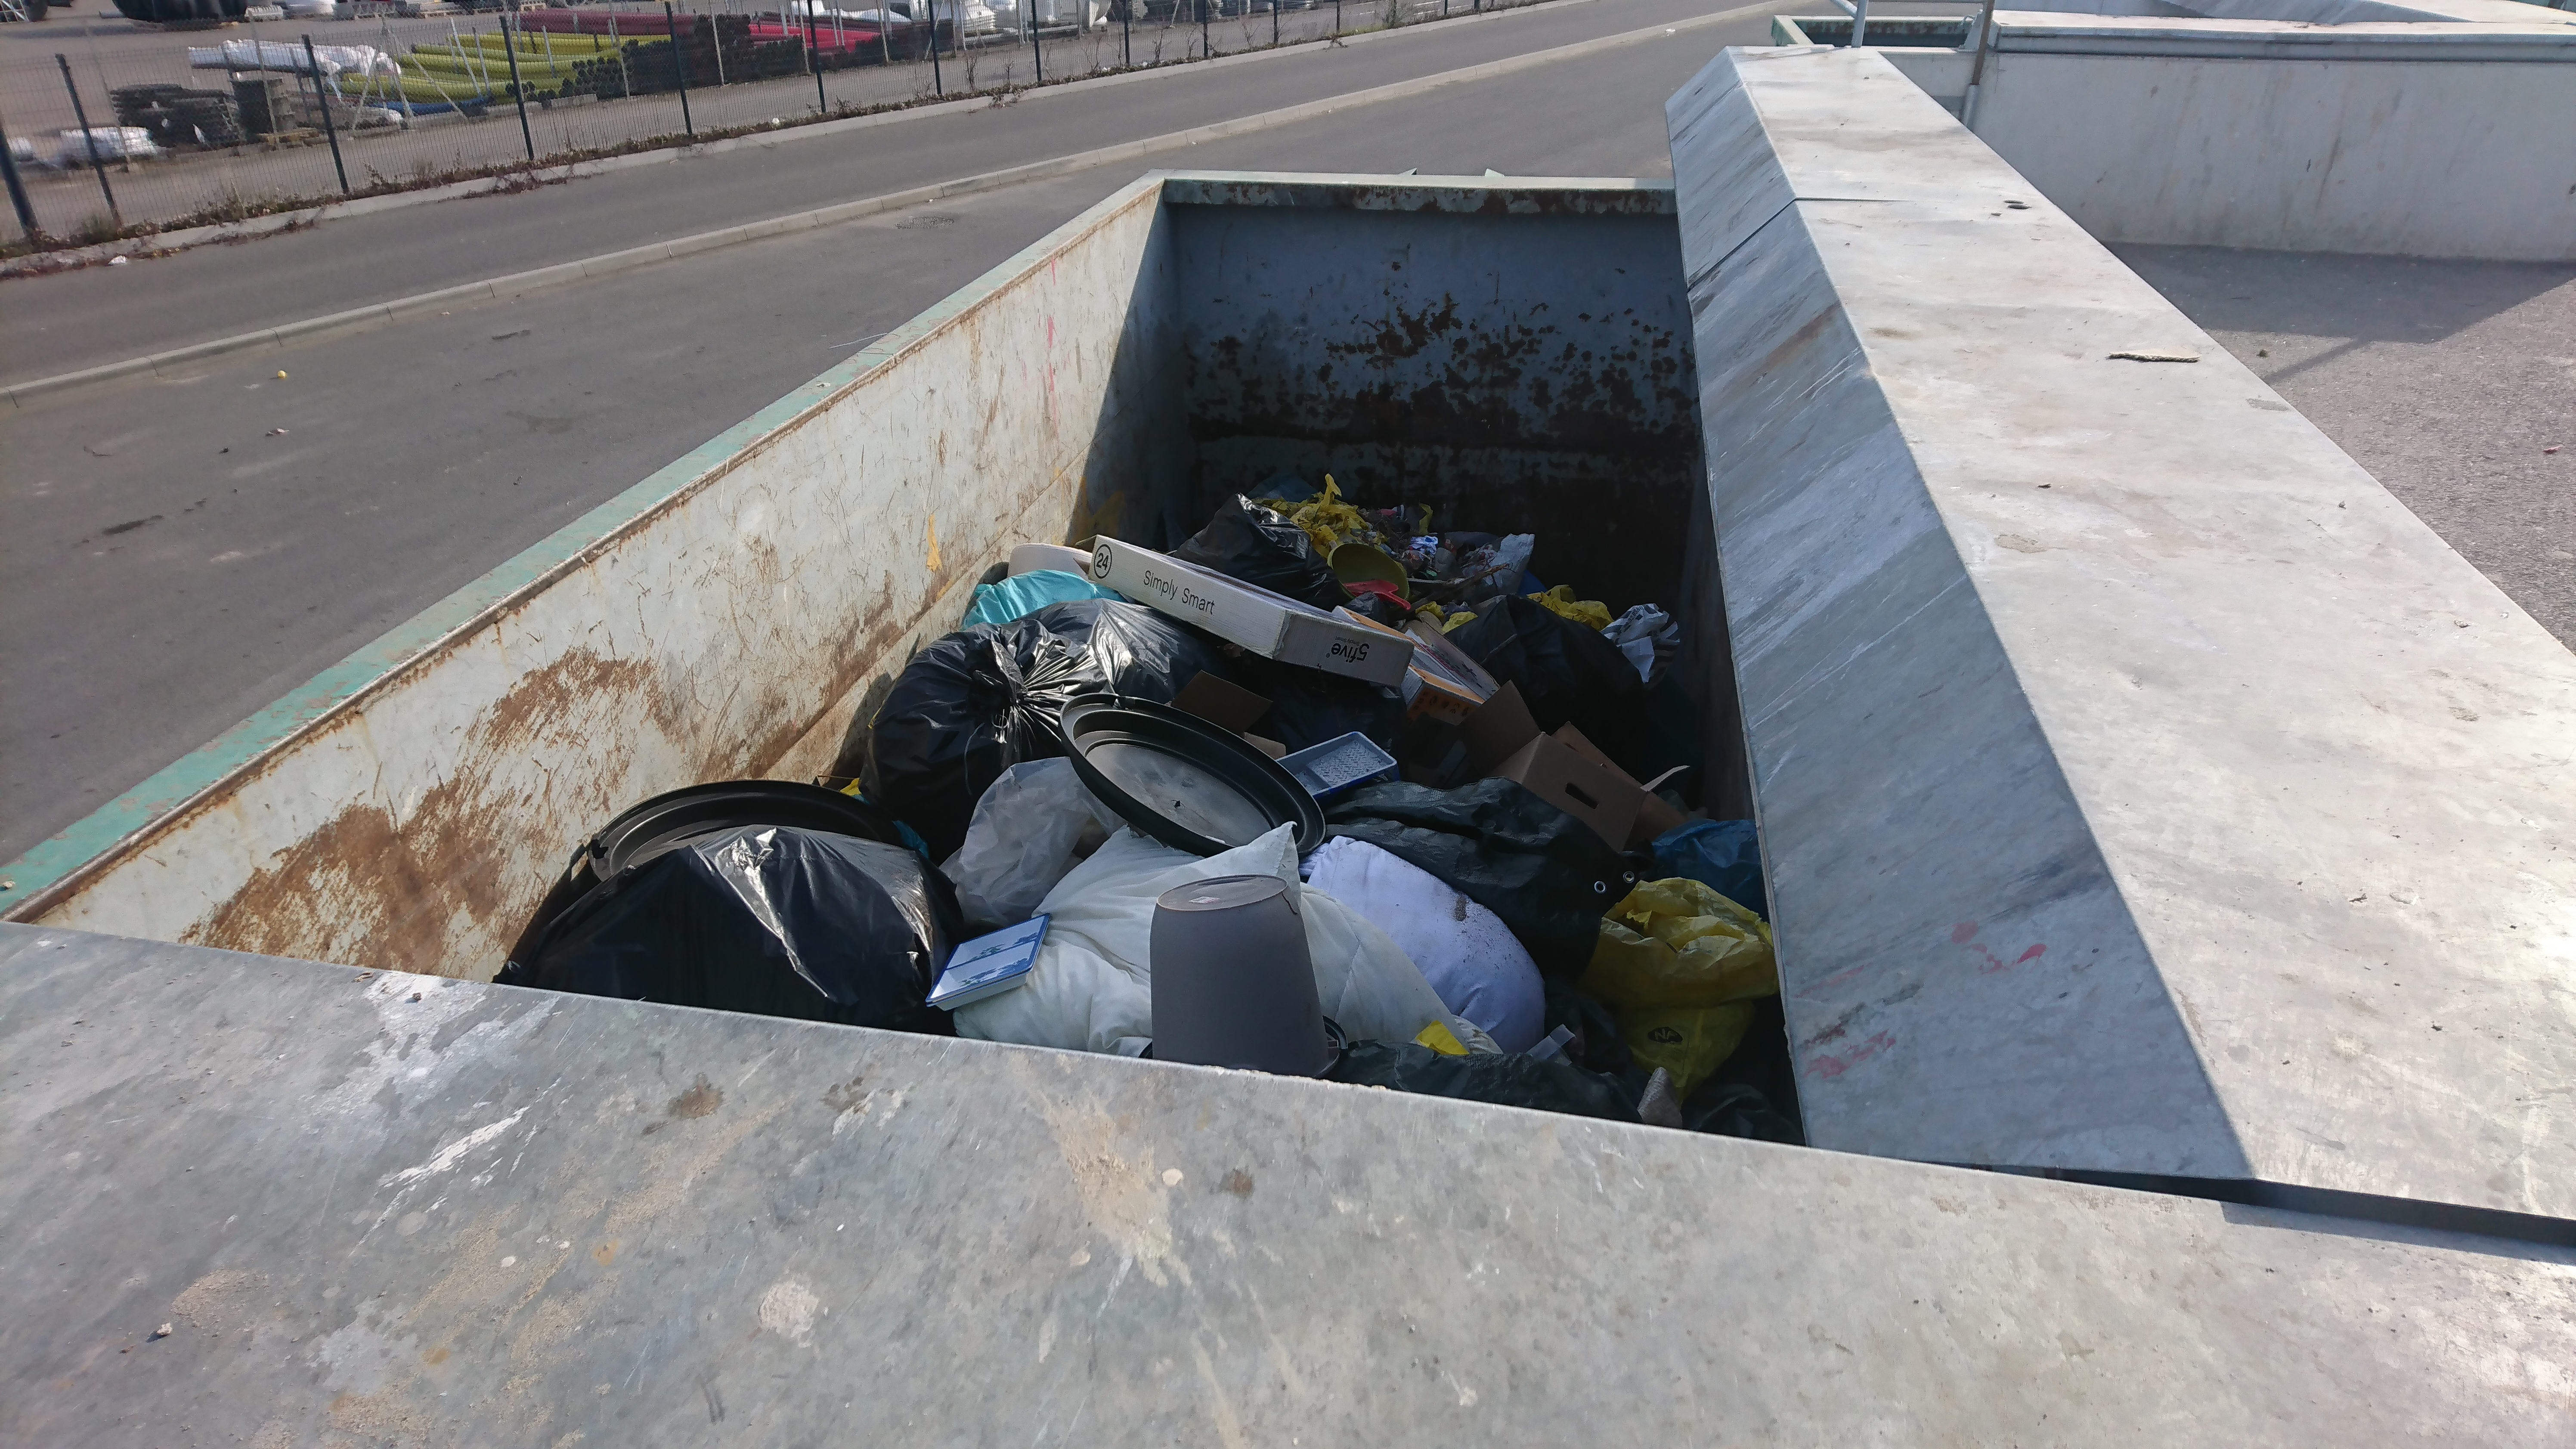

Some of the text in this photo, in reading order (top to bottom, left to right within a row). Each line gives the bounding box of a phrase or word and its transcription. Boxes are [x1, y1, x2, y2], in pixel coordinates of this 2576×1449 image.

[1096, 553, 1109, 570] 24
[1143, 570, 1215, 615] Simply Smart
